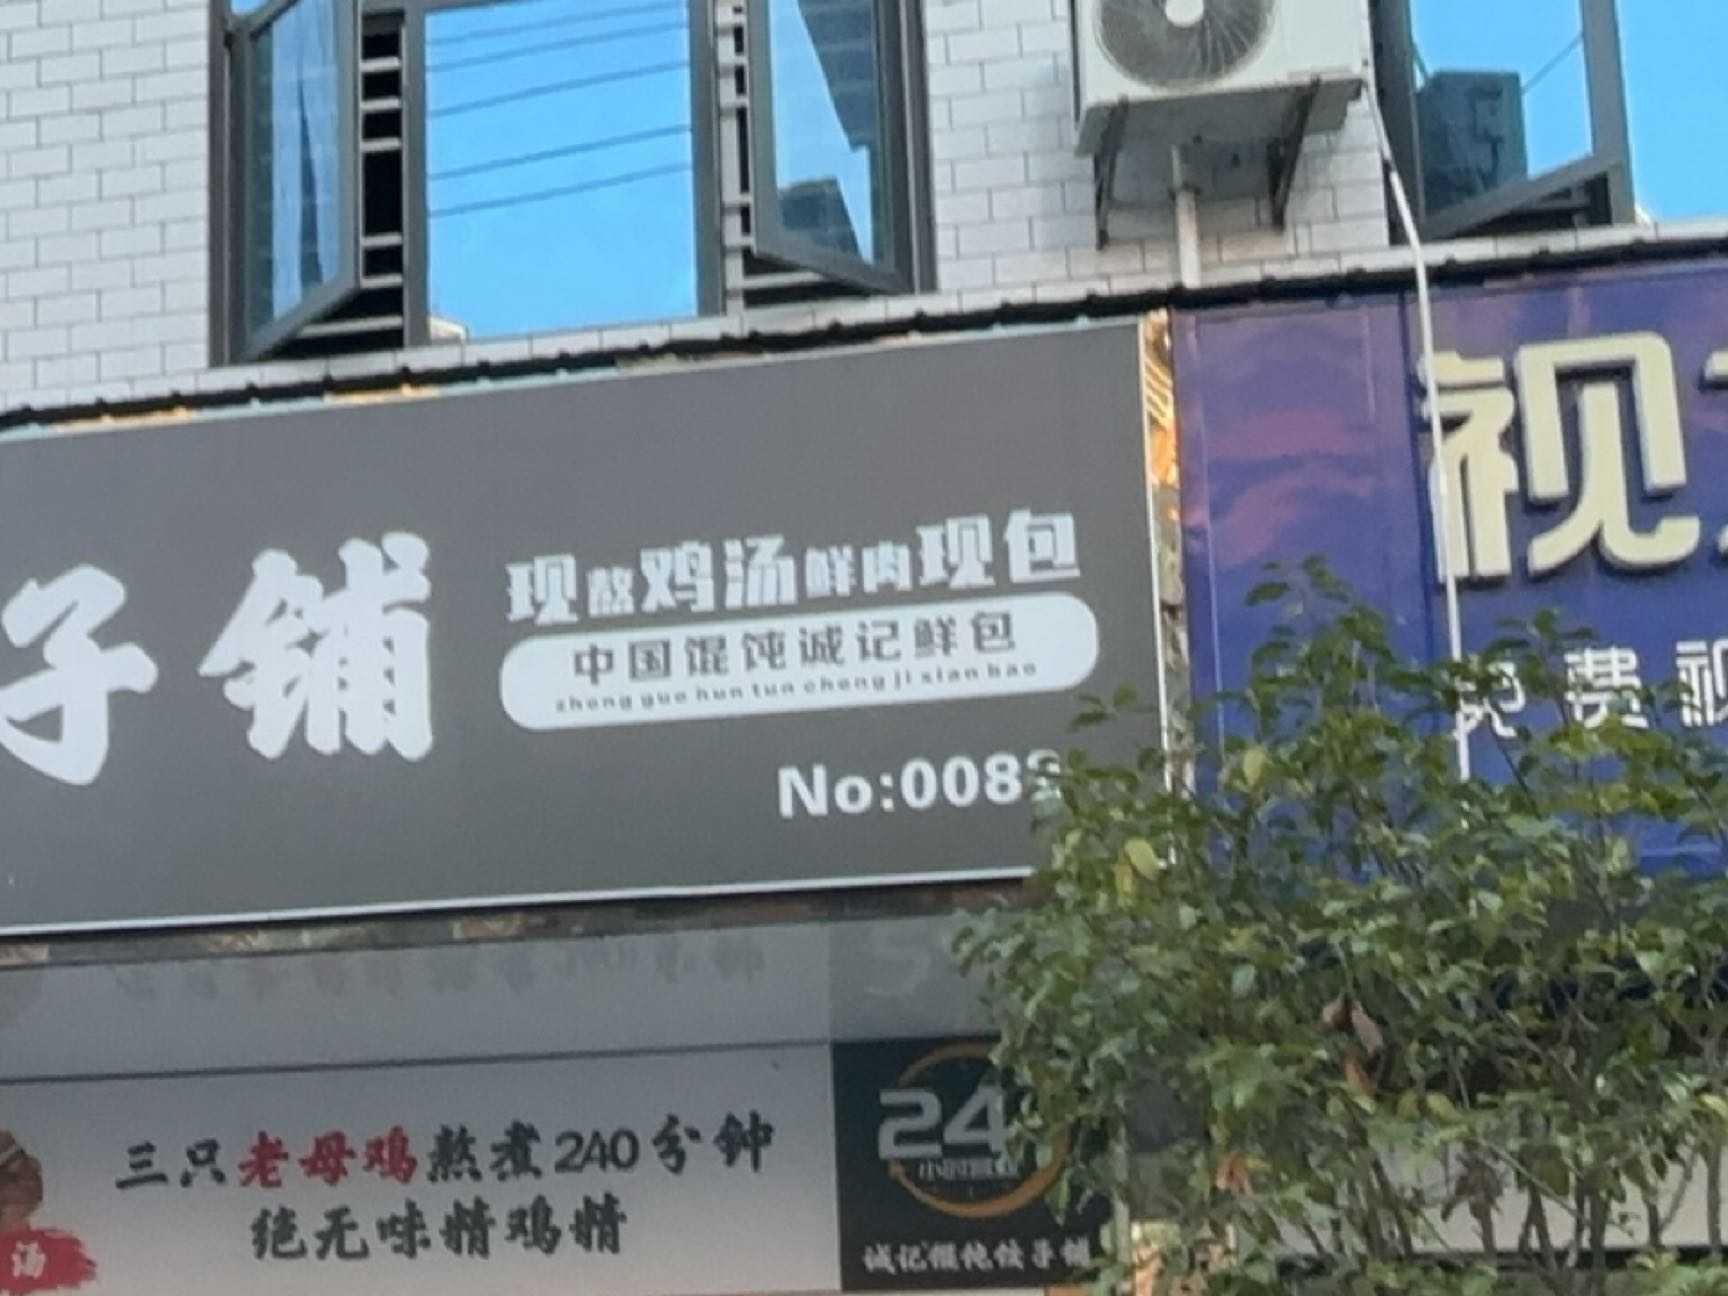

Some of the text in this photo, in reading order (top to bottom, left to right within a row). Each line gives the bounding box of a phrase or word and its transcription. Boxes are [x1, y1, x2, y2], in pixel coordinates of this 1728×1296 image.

[1420, 331, 1728, 580] 视
[506, 509, 1081, 625] 现熬鸡汤鲜肉现包
[574, 610, 1016, 685] 中国馄饨诚记鲜包
[251, 1193, 626, 1262] 绝无味精鸡精
